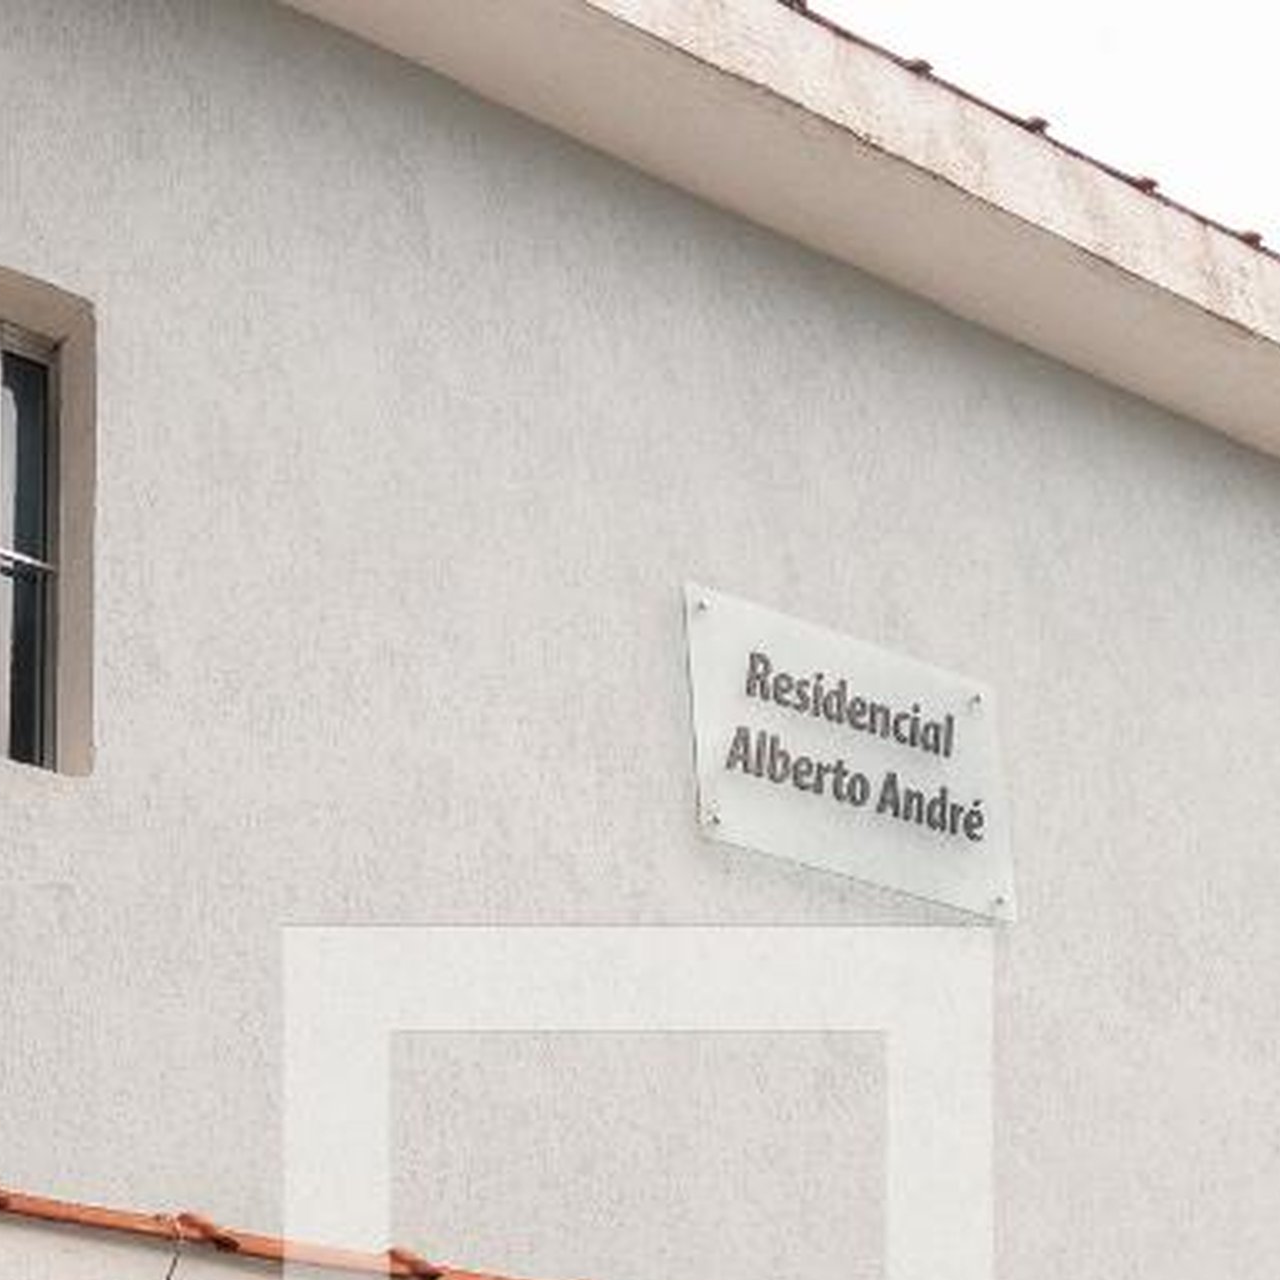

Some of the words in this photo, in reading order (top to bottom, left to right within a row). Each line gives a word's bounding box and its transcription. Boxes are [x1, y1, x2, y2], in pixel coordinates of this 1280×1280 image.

[744, 652, 956, 758] Residencial
[724, 725, 870, 807] Alberto
[876, 772, 984, 842] André
